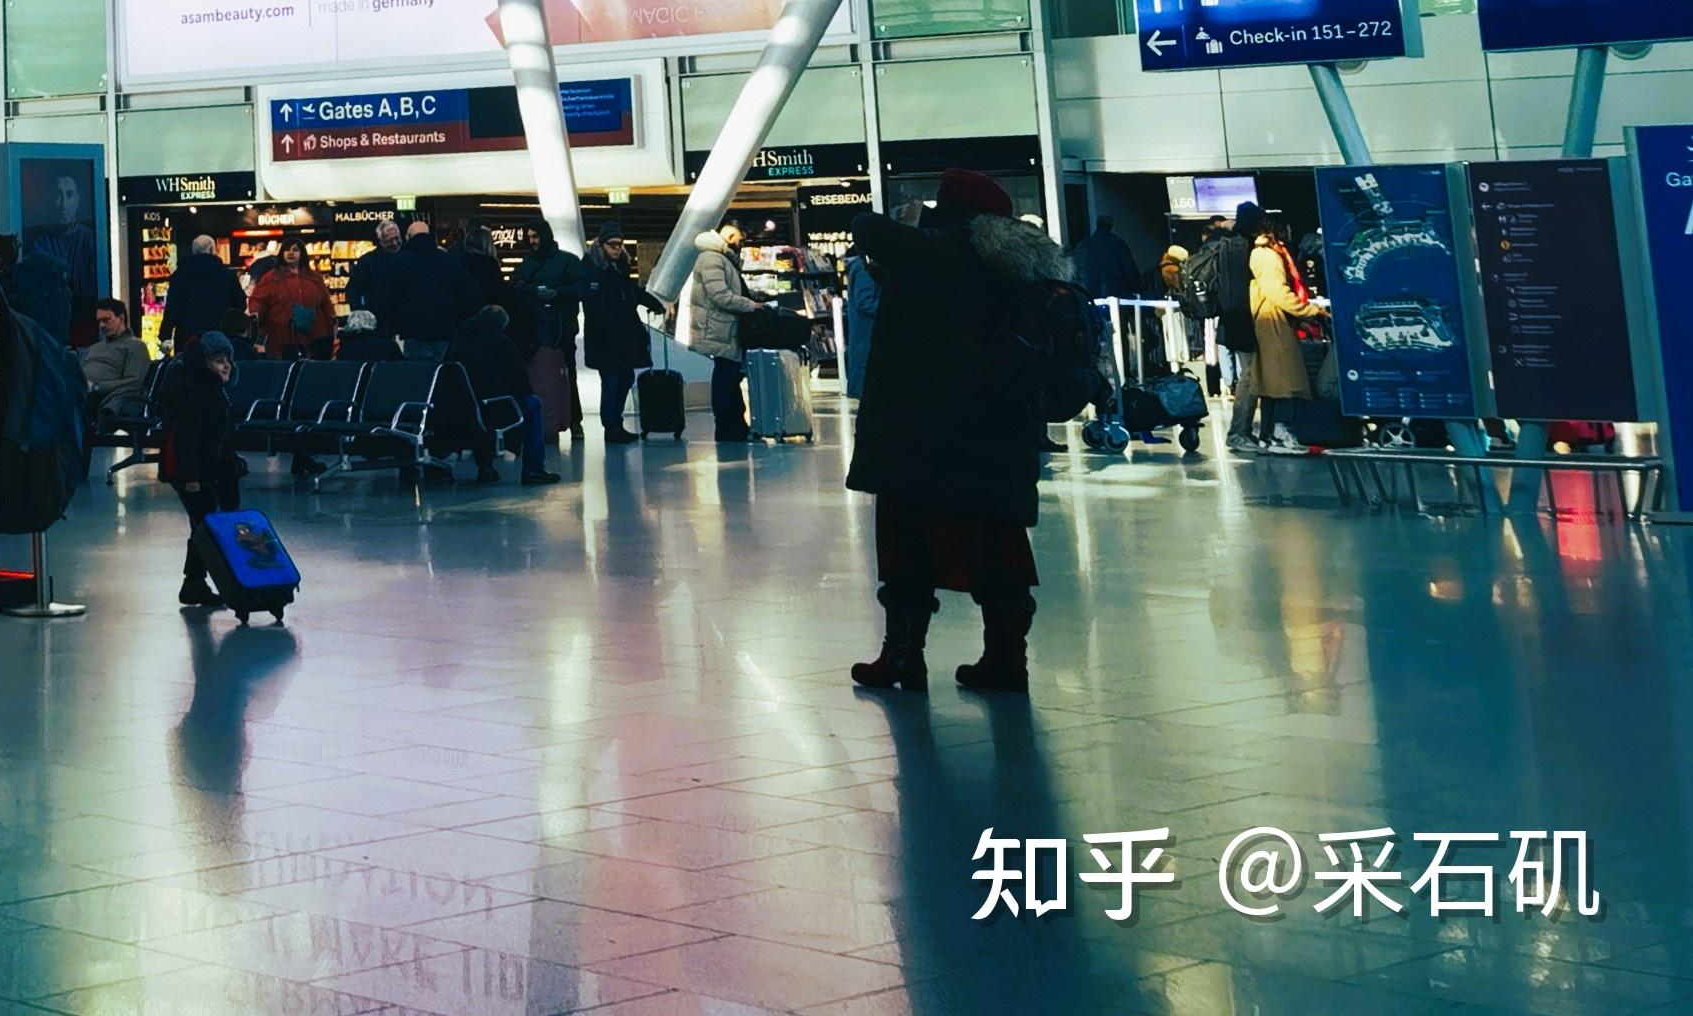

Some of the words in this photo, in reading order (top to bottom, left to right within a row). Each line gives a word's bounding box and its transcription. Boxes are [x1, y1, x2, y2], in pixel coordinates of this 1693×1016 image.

[180, 4, 295, 25] asambeauty.com
[1229, 26, 1307, 45] Check-in
[319, 98, 374, 122] Gates
[320, 134, 358, 150] Shops
[360, 133, 370, 146] &
[372, 129, 446, 146] Restaurants
[752, 148, 814, 167] HSmith
[768, 165, 815, 177] EXPRESS
[1666, 171, 1693, 187] Ga
[180, 190, 216, 200] EXPRESS
[335, 210, 394, 222] MALBÜCHER
